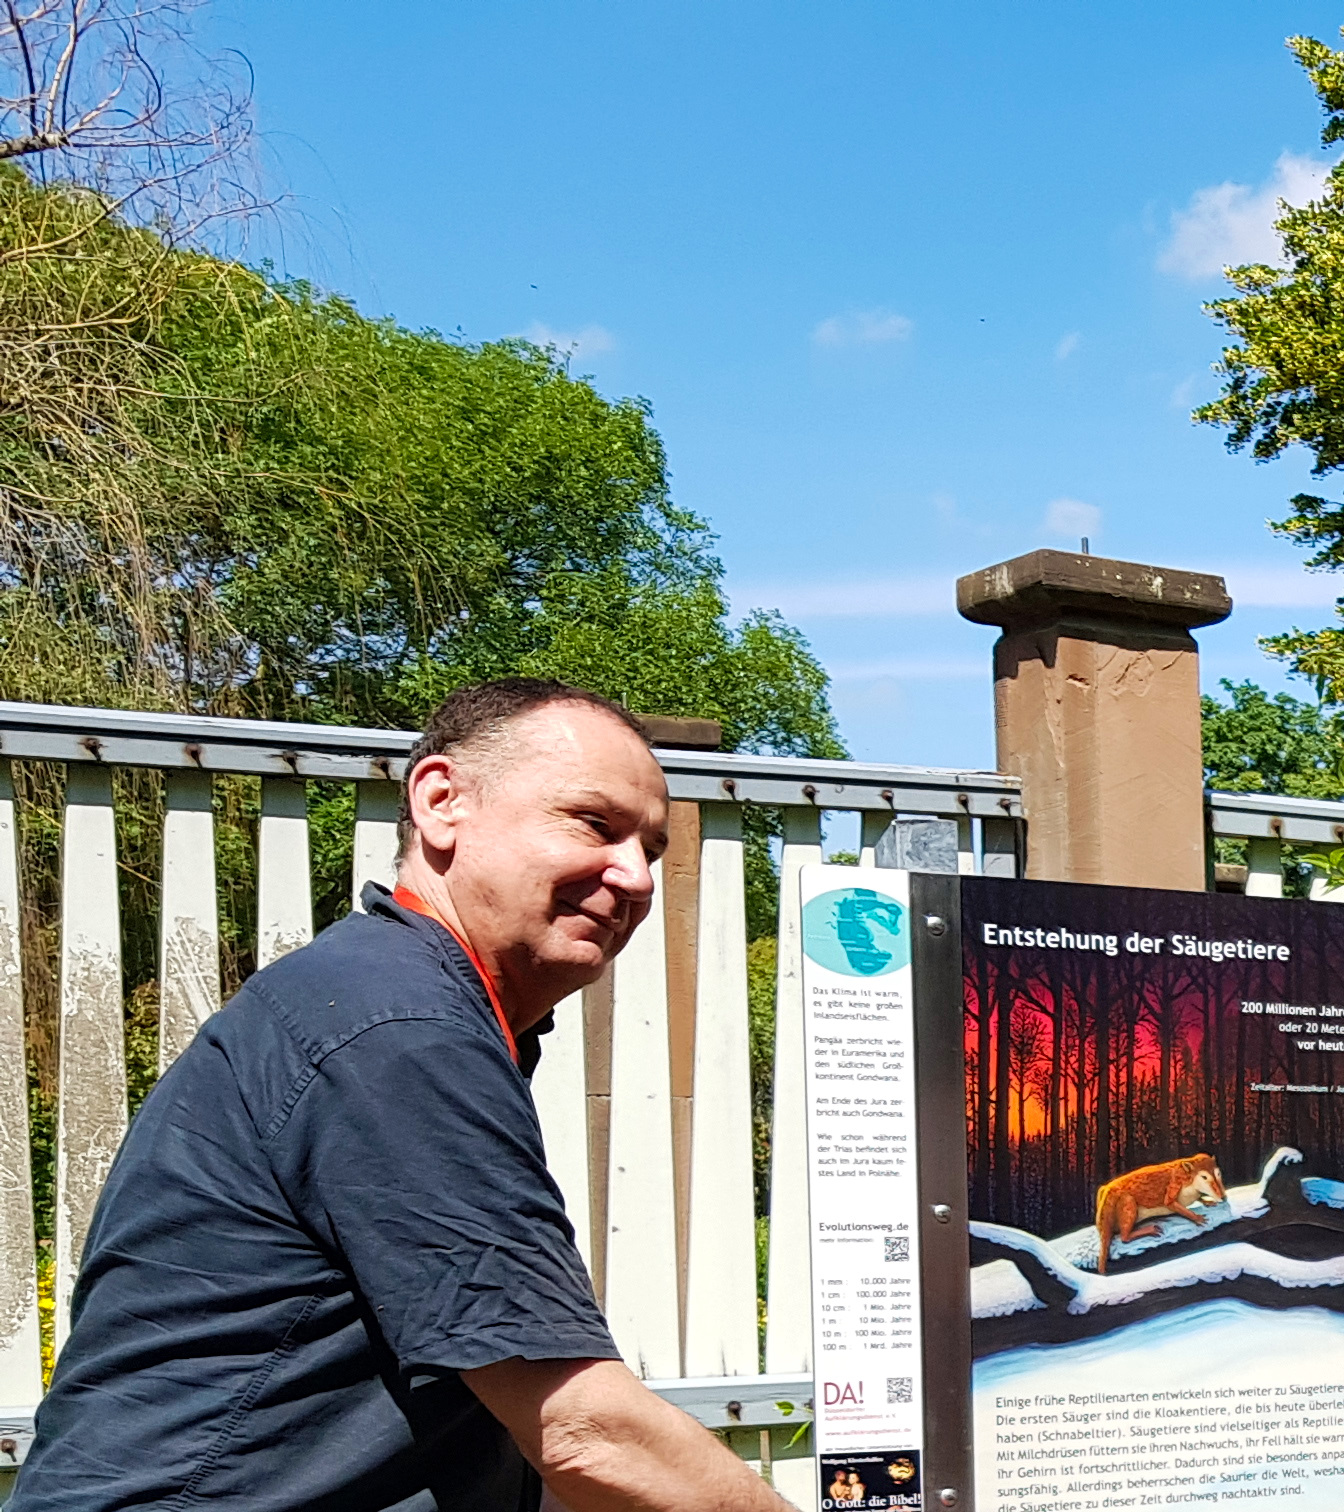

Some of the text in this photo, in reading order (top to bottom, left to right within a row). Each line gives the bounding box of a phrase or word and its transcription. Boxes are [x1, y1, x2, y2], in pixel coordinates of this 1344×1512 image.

[983, 924, 1290, 961] Entstehung der Säugetiere
[1240, 1001, 1263, 1014] 200
[1265, 1002, 1316, 1016] Millionen
[1278, 1021, 1303, 1032] oder
[1305, 1021, 1319, 1033] 20
[1296, 1040, 1316, 1050] vor
[818, 1222, 909, 1232] Evolutionsweg.de
[823, 1381, 864, 1405] DA!
[995, 1396, 1032, 1410] Einige
[1034, 1394, 1066, 1406] frühe
[1068, 1392, 1149, 1405] Reptilienarten
[1151, 1389, 1212, 1401] entwickeln
[1214, 1387, 1235, 1398] sich
[1237, 1387, 1272, 1397] weiter
[1274, 1386, 1287, 1396] zu
[996, 1414, 1016, 1426] Die
[1019, 1414, 1058, 1425] ersten
[1062, 1411, 1102, 1424] Säuger
[1105, 1408, 1129, 1421] sind
[1132, 1409, 1151, 1419] die
[1154, 1406, 1230, 1418] Kloakentiere,
[1234, 1403, 1252, 1414] die
[1255, 1403, 1271, 1414] bis
[1274, 1402, 1306, 1412] heute
[996, 1432, 1034, 1444] haben
[1037, 1428, 1125, 1442] (Schnabeltier).
[1129, 1425, 1191, 1438] Säugetiere
[1194, 1422, 1217, 1434] sind
[1219, 1420, 1281, 1432] vielseitiger
[1284, 1417, 1299, 1429] als
[996, 1450, 1015, 1461] Mit
[1017, 1448, 1086, 1460] Milchdrüsen
[1088, 1445, 1129, 1456] füttern
[1131, 1444, 1147, 1454] sie
[1149, 1442, 1178, 1452] ihren
[1179, 1439, 1242, 1451] Nachwuchs,
[1245, 1436, 1260, 1447] ihr
[1262, 1435, 1281, 1446] Fell
[1283, 1434, 1304, 1445] hält
[1305, 1434, 1320, 1444] sie
[997, 1468, 1014, 1479] ihr
[1016, 1466, 1056, 1478] Gehirn
[1060, 1465, 1074, 1476] ist
[1078, 1460, 1170, 1474] fortschrittlicher.
[1174, 1456, 1219, 1468] Dadurch
[1222, 1454, 1244, 1466] sind
[1247, 1454, 1263, 1464] sie
[1266, 1451, 1318, 1463] besonders
[997, 1483, 1062, 1498] sungsfähig.
[1066, 1480, 1123, 1492] Allerdings
[1126, 1476, 1195, 1488] beherrschen
[1198, 1473, 1216, 1484] die
[1219, 1471, 1258, 1483] Saurier
[1261, 1469, 1278, 1480] die
[1281, 1467, 1309, 1479] Welt,
[822, 1492, 922, 1510] O Gott: die Bibel!
[1085, 1500, 1099, 1509] zu
[1102, 1497, 1136, 1508] dieser
[1140, 1494, 1162, 1505] Zeit
[1165, 1491, 1218, 1503] durchweg
[1221, 1487, 1277, 1499] nachtaktiv
[1280, 1484, 1304, 1496] sind.
